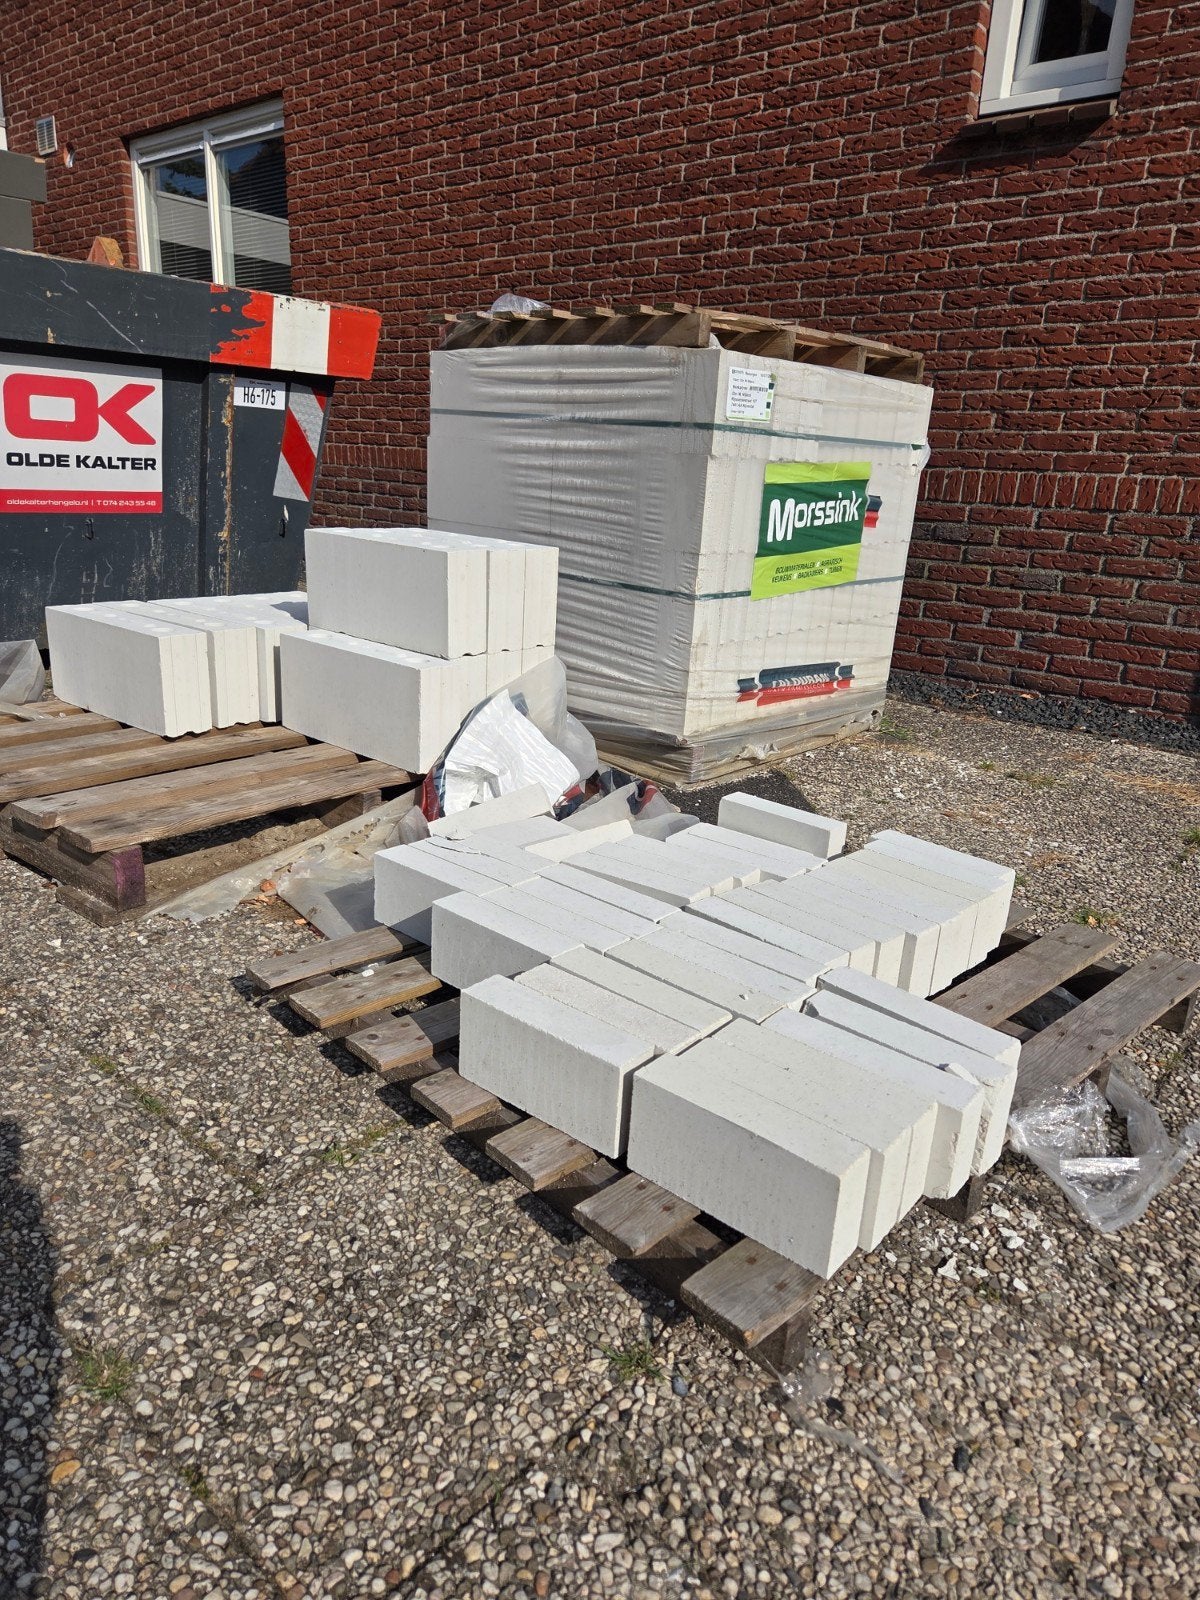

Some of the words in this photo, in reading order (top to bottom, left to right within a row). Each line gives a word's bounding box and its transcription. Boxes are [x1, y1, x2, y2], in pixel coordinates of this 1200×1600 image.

[243, 386, 276, 406] H6-175
[3, 373, 157, 446] OK
[6, 452, 71, 468] OLDE
[75, 454, 157, 471] KALTER
[6, 499, 89, 507] oldekalterhengelo.nl
[766, 490, 863, 543] Morssink
